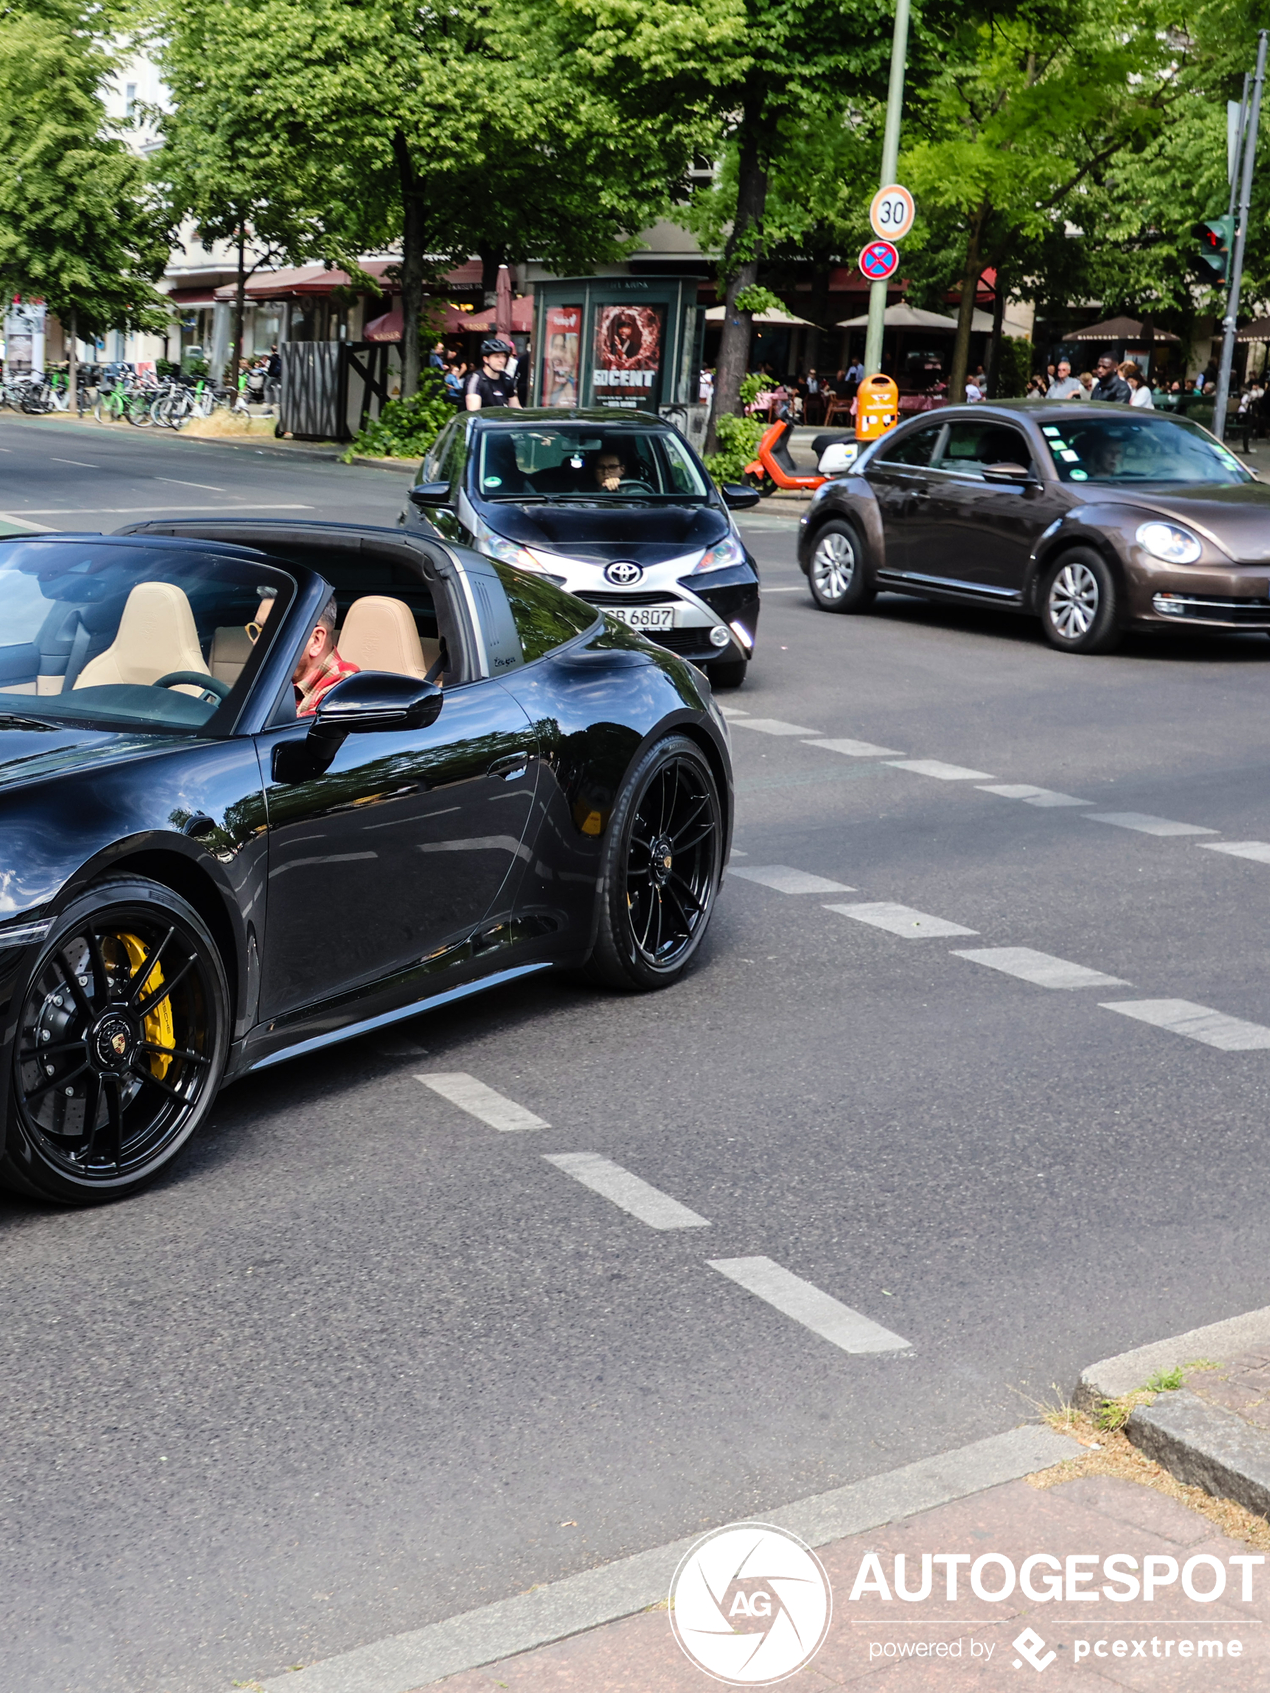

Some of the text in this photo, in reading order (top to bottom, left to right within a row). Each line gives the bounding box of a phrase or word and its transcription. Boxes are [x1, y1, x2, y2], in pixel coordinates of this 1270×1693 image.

[880, 201, 904, 224] 30
[463, 323, 489, 331] KAISER
[373, 331, 401, 341] KAISER
[630, 610, 671, 625] 6807
